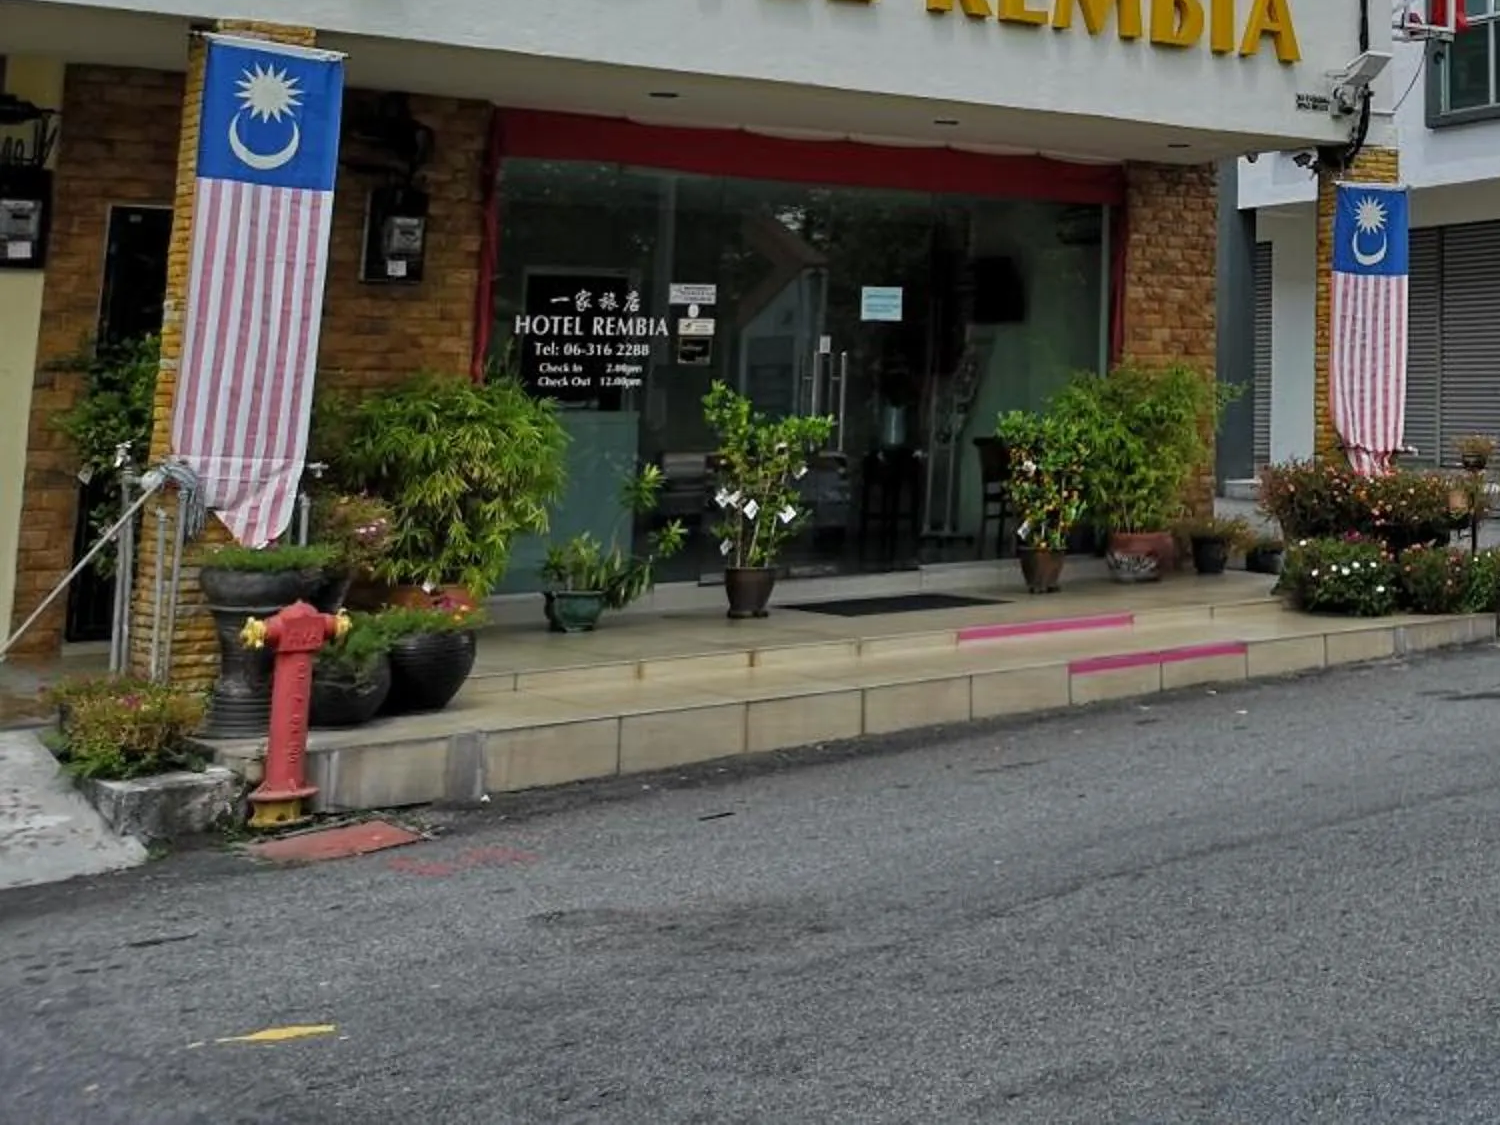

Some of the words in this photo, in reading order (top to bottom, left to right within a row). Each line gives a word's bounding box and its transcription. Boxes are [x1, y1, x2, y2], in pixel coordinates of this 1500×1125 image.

[514, 314, 584, 336] HOTEL
[592, 316, 669, 336] REMBIA
[534, 342, 559, 356] Tel:
[563, 342, 612, 356] 06-316
[616, 344, 650, 356] 2288
[539, 362, 569, 373] Check
[572, 363, 583, 373] In
[537, 377, 568, 387] Check
[571, 377, 591, 387] Out
